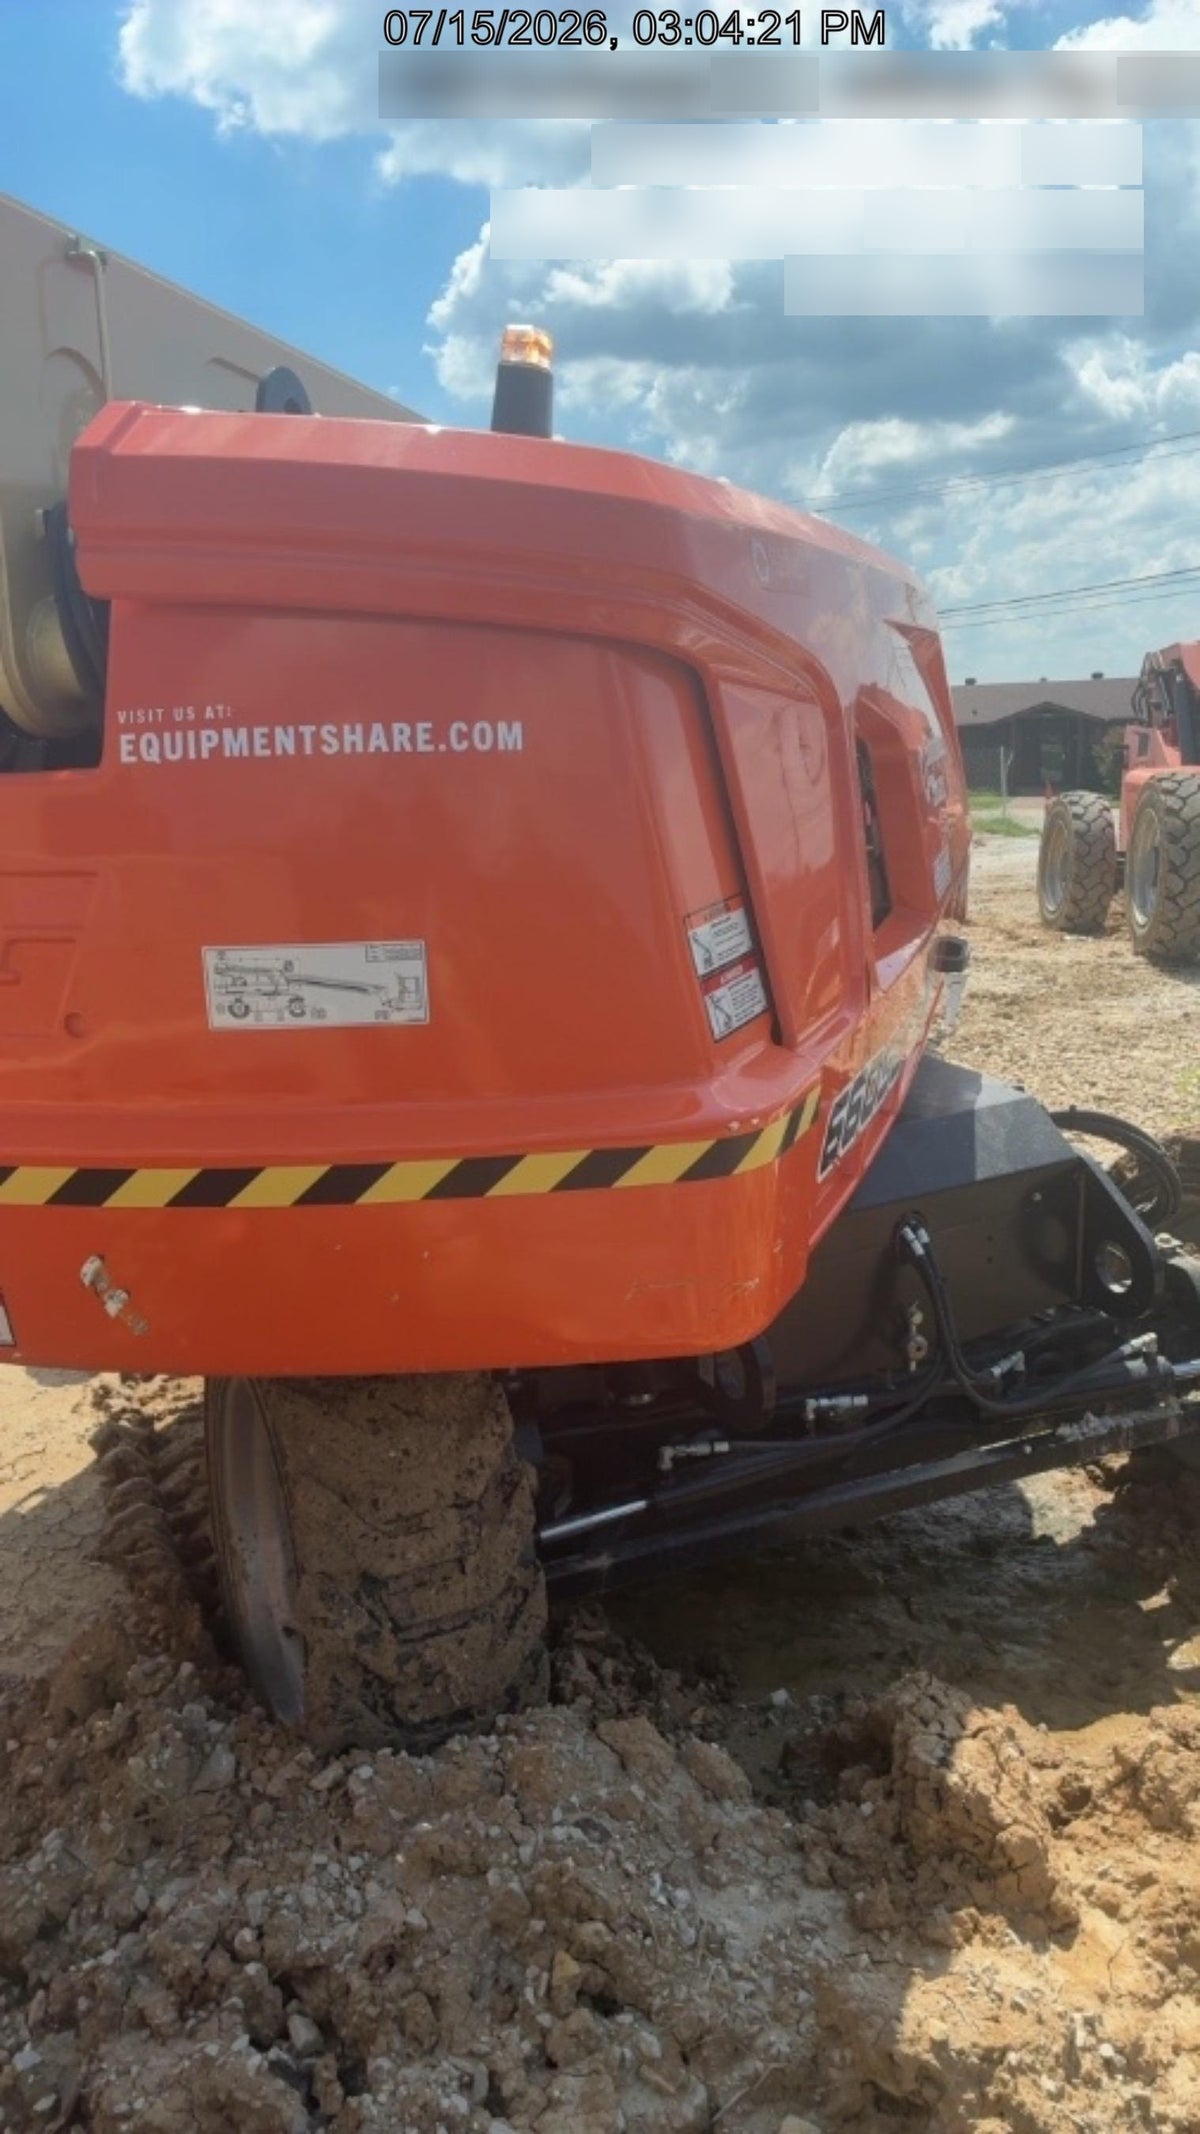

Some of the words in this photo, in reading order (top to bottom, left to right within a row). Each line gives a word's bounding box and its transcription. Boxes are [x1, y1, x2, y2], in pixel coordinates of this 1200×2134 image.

[117, 708, 164, 724] VISIT
[173, 706, 196, 722] US
[119, 721, 523, 764] EQUIPMENTSHARE.COM
